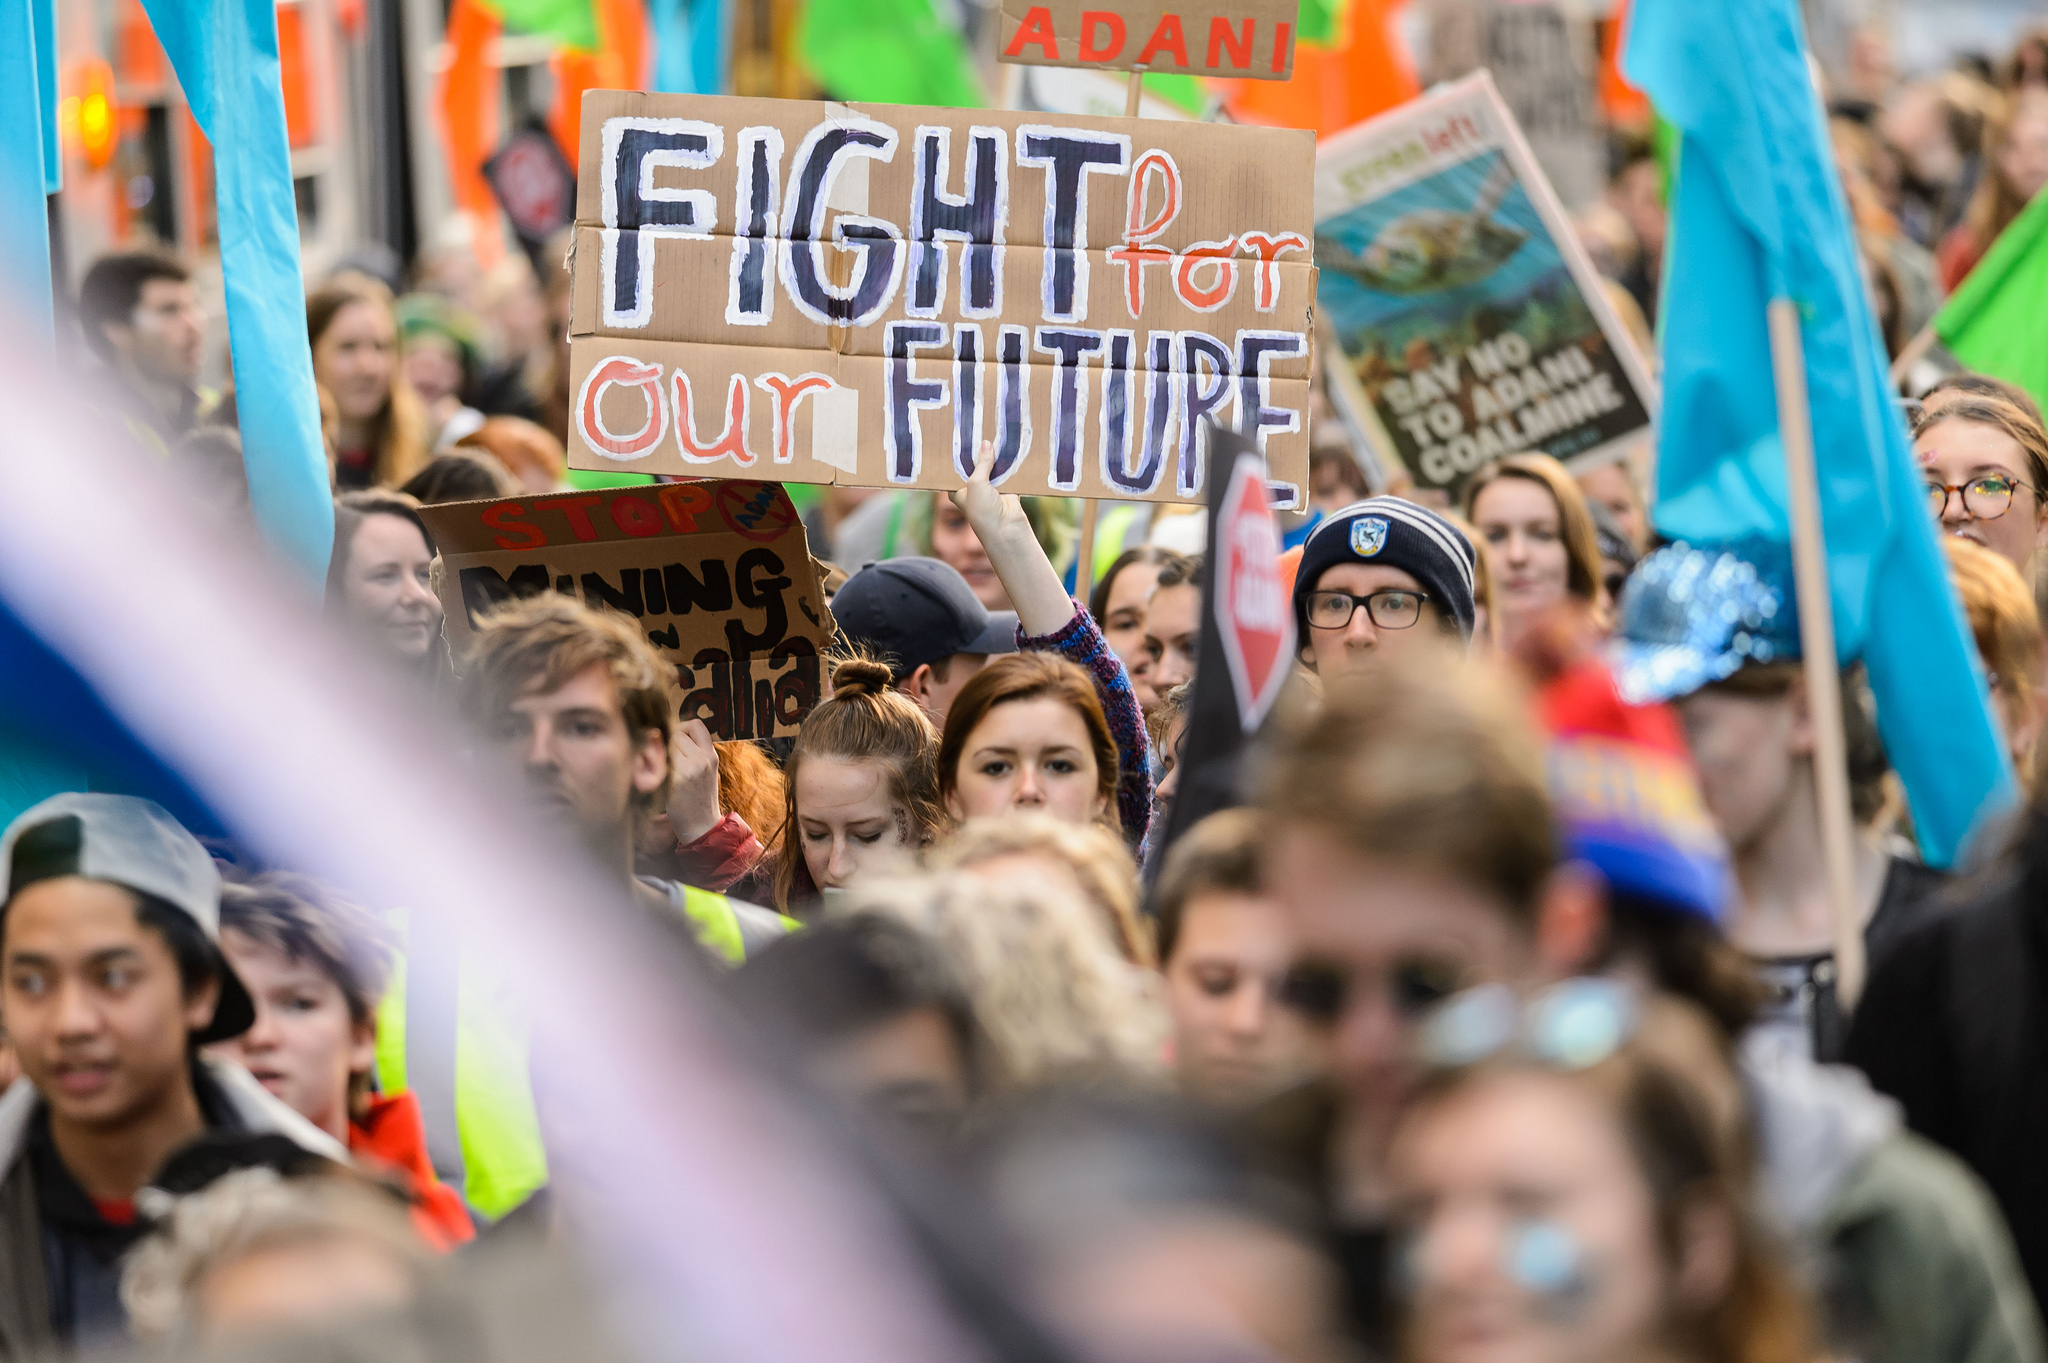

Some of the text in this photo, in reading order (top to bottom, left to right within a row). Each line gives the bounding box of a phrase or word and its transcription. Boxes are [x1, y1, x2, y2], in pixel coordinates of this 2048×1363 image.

[1003, 6, 1291, 73] ADANI
[601, 117, 1309, 328] FIGHT for
[883, 320, 1308, 510] FUTURE
[1381, 332, 1531, 415] SAY NO
[1399, 344, 1594, 449] TO ADANI
[1418, 371, 1626, 484] COALMINE
[481, 485, 713, 550] STOP
